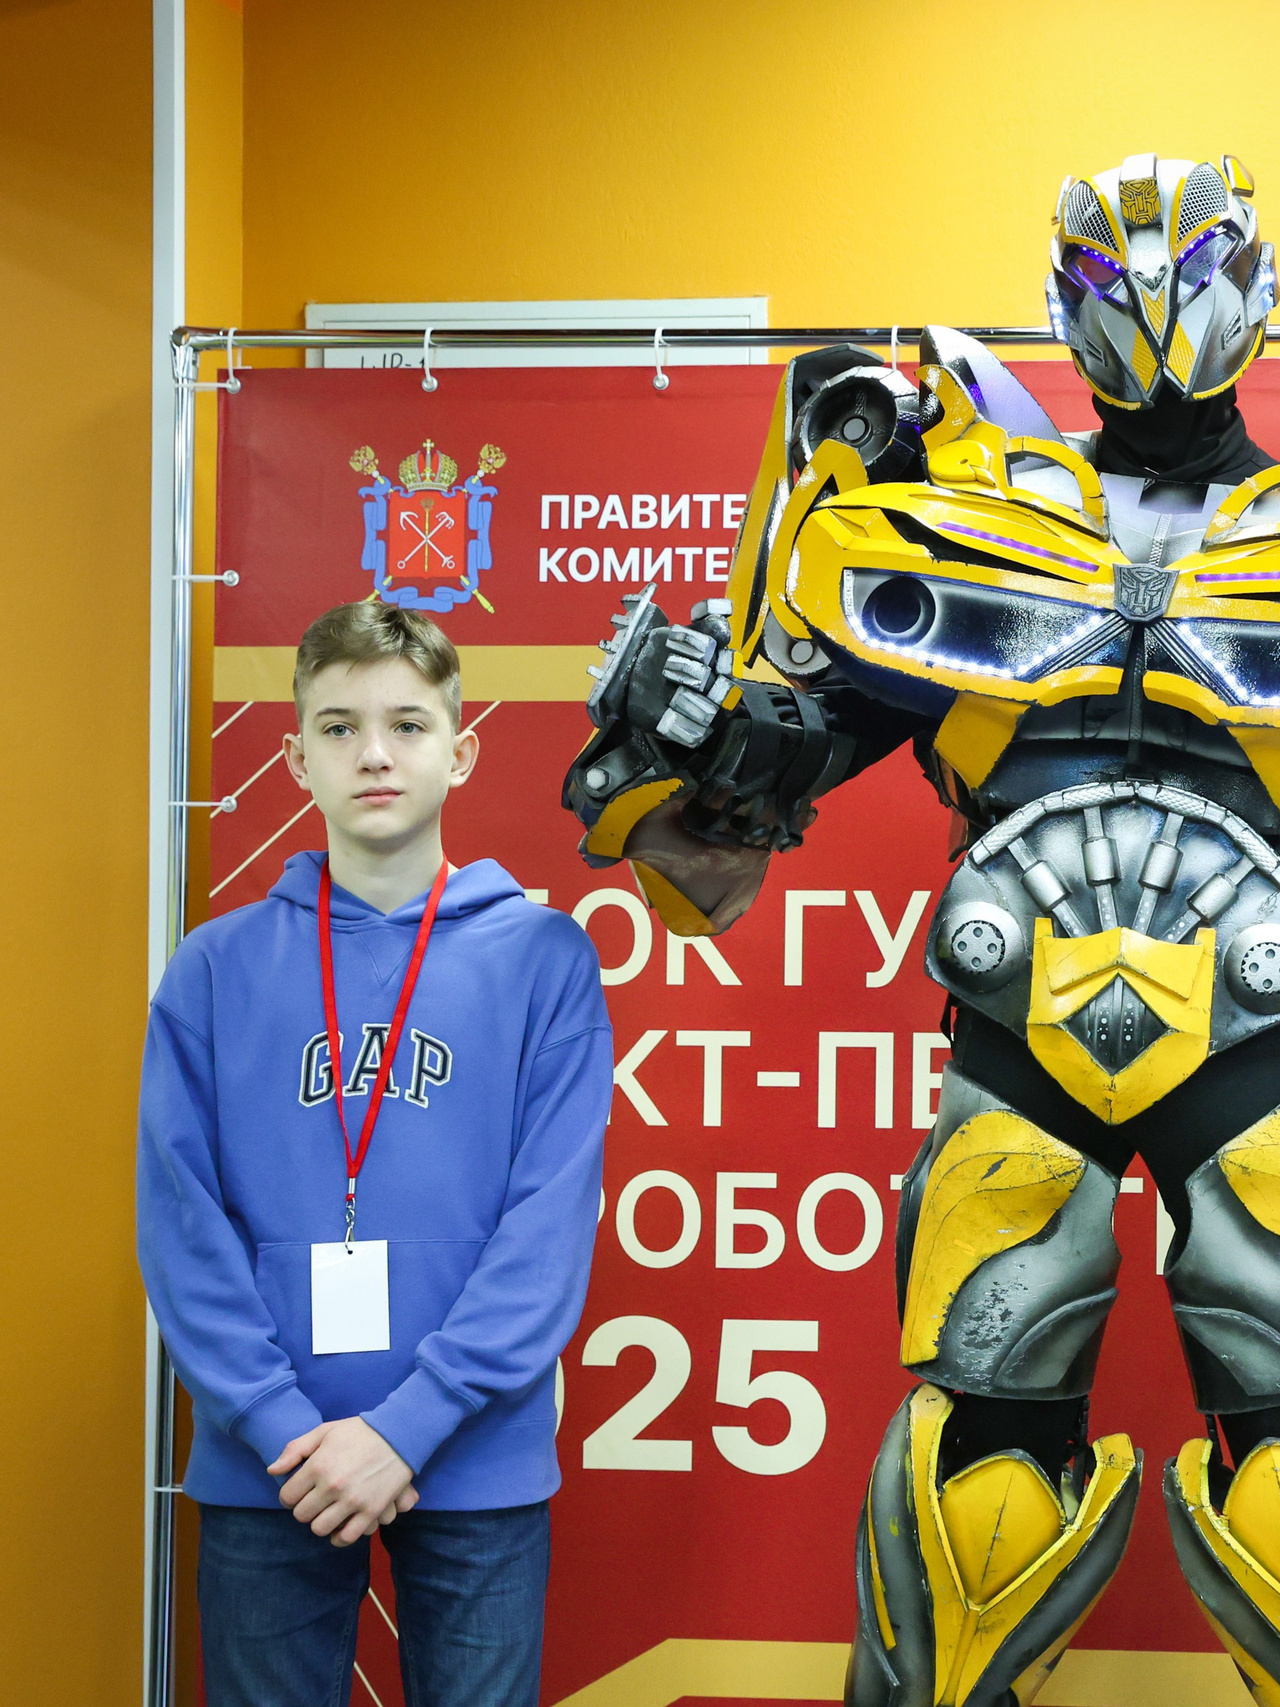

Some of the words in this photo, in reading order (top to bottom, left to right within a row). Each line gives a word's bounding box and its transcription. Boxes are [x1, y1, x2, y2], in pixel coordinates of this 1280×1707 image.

[540, 494, 748, 529] ПРАВИТЕ
[539, 547, 737, 582] КОМИТЕ
[523, 887, 742, 986] ОК
[298, 1023, 453, 1108] GAP
[606, 1029, 955, 1129] КТ-ПЕ
[597, 1169, 904, 1272] ОБО
[555, 1315, 826, 1476] 25
